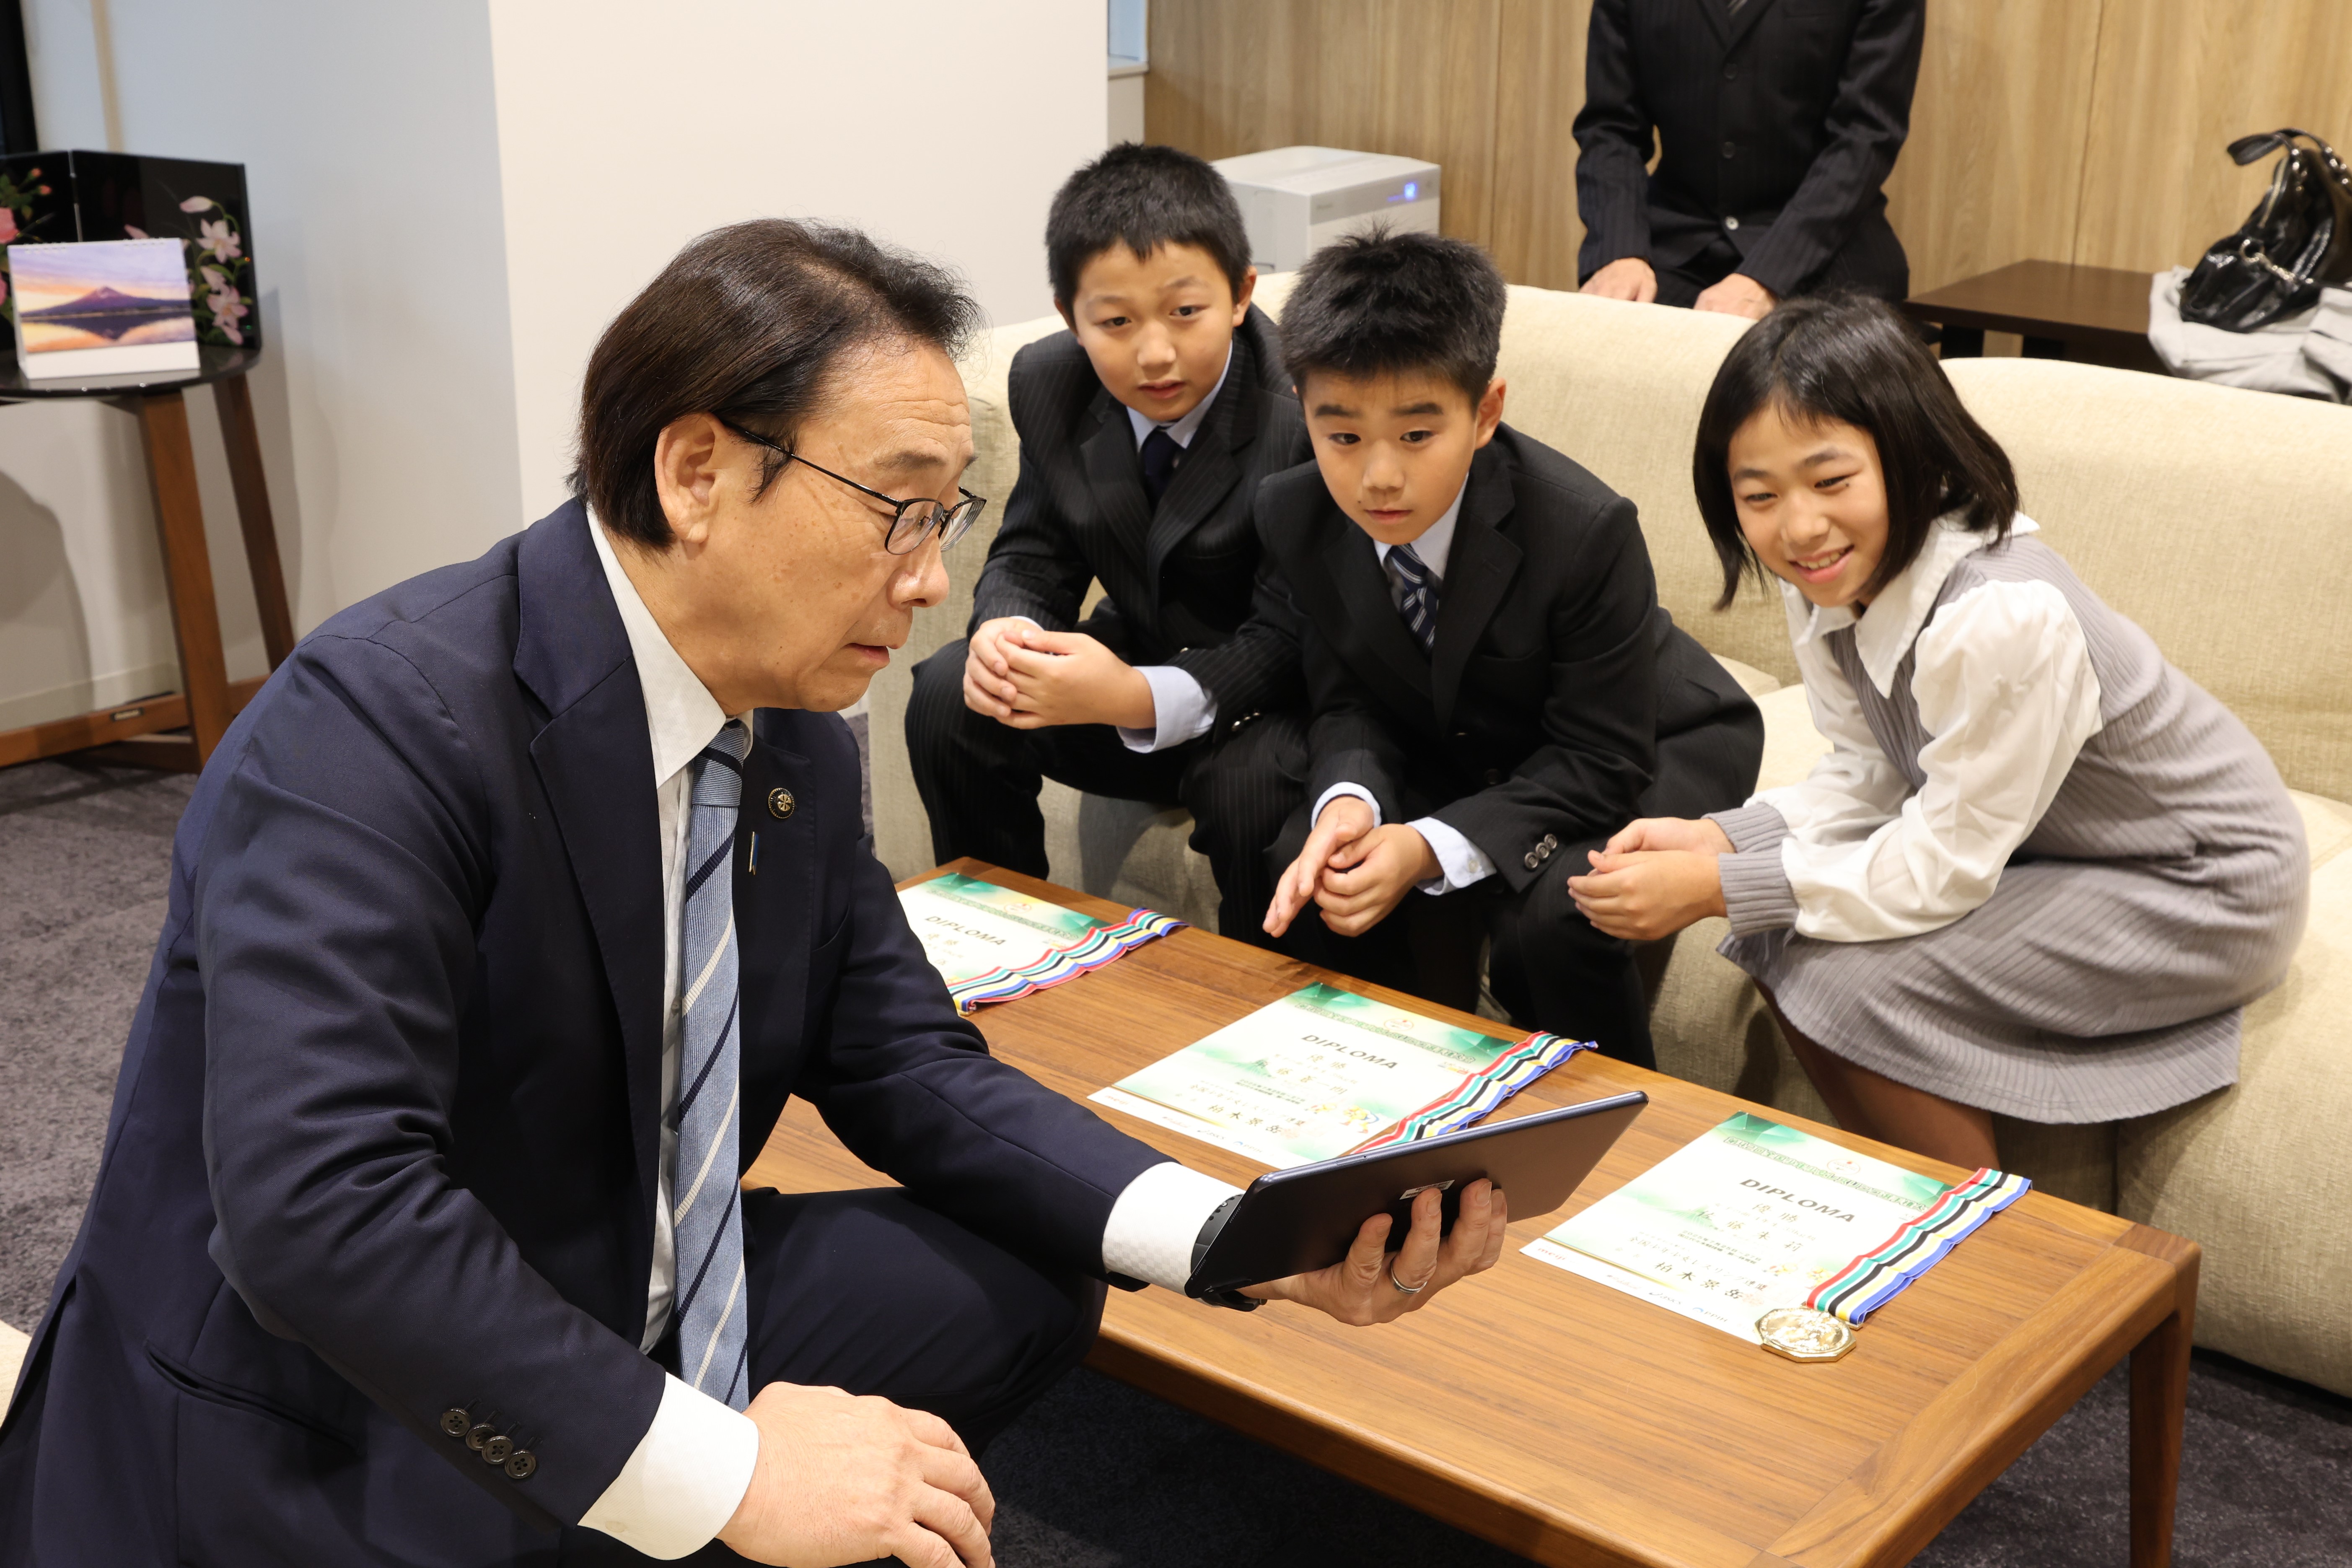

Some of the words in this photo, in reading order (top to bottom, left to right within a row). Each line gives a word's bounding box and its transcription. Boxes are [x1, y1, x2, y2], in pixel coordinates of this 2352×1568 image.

[925, 916, 1006, 945] DIPLOMA
[1301, 1035, 1398, 1069] DIPLOMA
[1723, 1137, 1929, 1213] 第42回全国少年少女レスリング選手権大
[1739, 1179, 1855, 1222] DIPLOMA
[1537, 1248, 1566, 1260] meiji
[1704, 1311, 1728, 1322] PPIH
